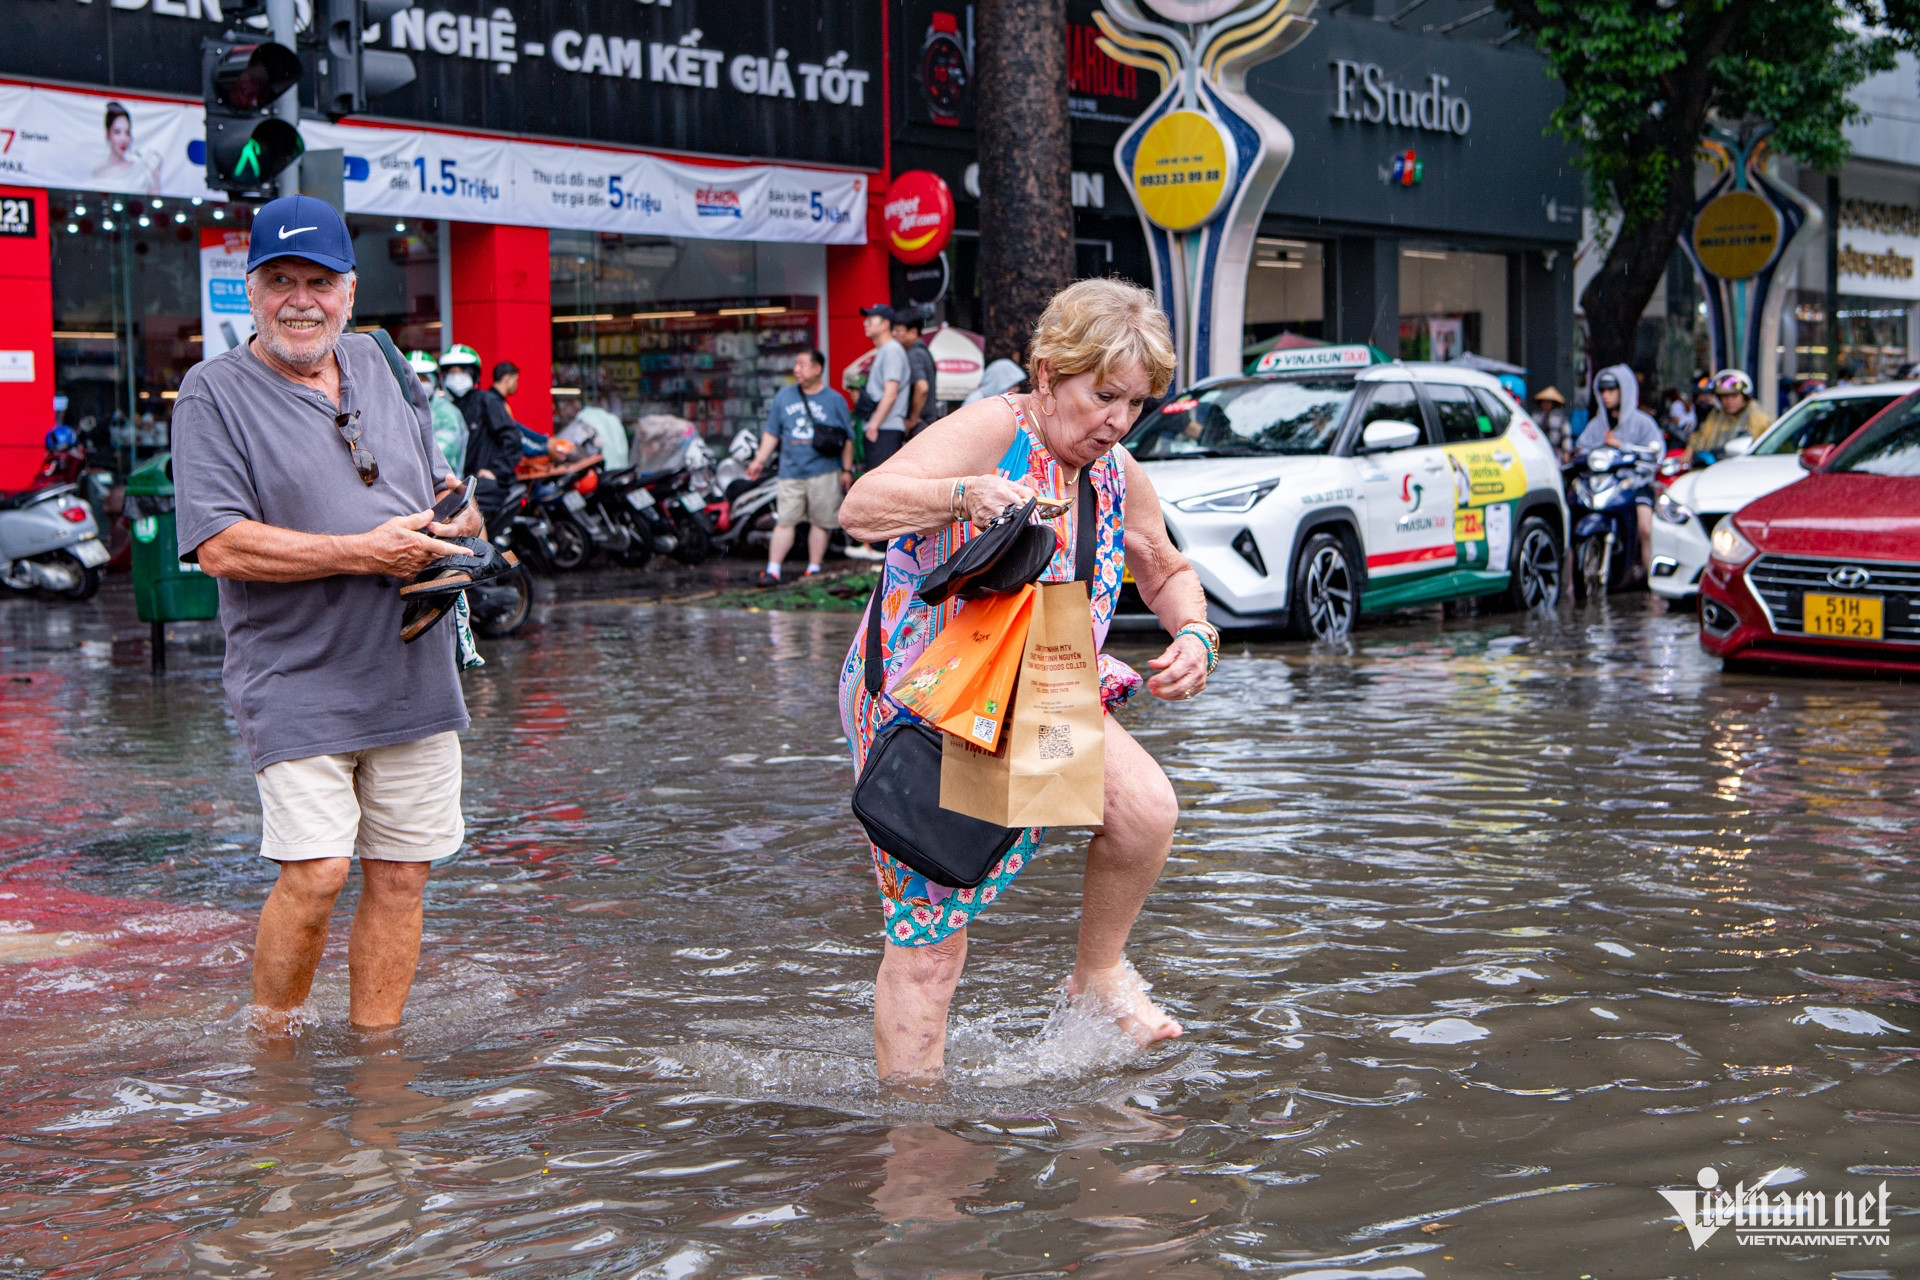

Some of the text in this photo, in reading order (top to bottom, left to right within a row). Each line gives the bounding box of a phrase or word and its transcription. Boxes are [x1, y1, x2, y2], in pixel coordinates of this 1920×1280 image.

[392, 8, 518, 74] NGHỆ
[552, 30, 642, 79] CAM
[650, 29, 724, 88] KẾT
[731, 48, 795, 98] GIÁ
[799, 50, 869, 106] TỐT
[414, 156, 500, 204] 1.5 Triệu
[533, 169, 552, 184] Thu
[608, 175, 662, 216] 5 Triệu
[810, 191, 824, 222] 5
[1284, 352, 1342, 365] VINASUN
[1825, 597, 1861, 616] 51H
[1815, 615, 1874, 636] 119.23
